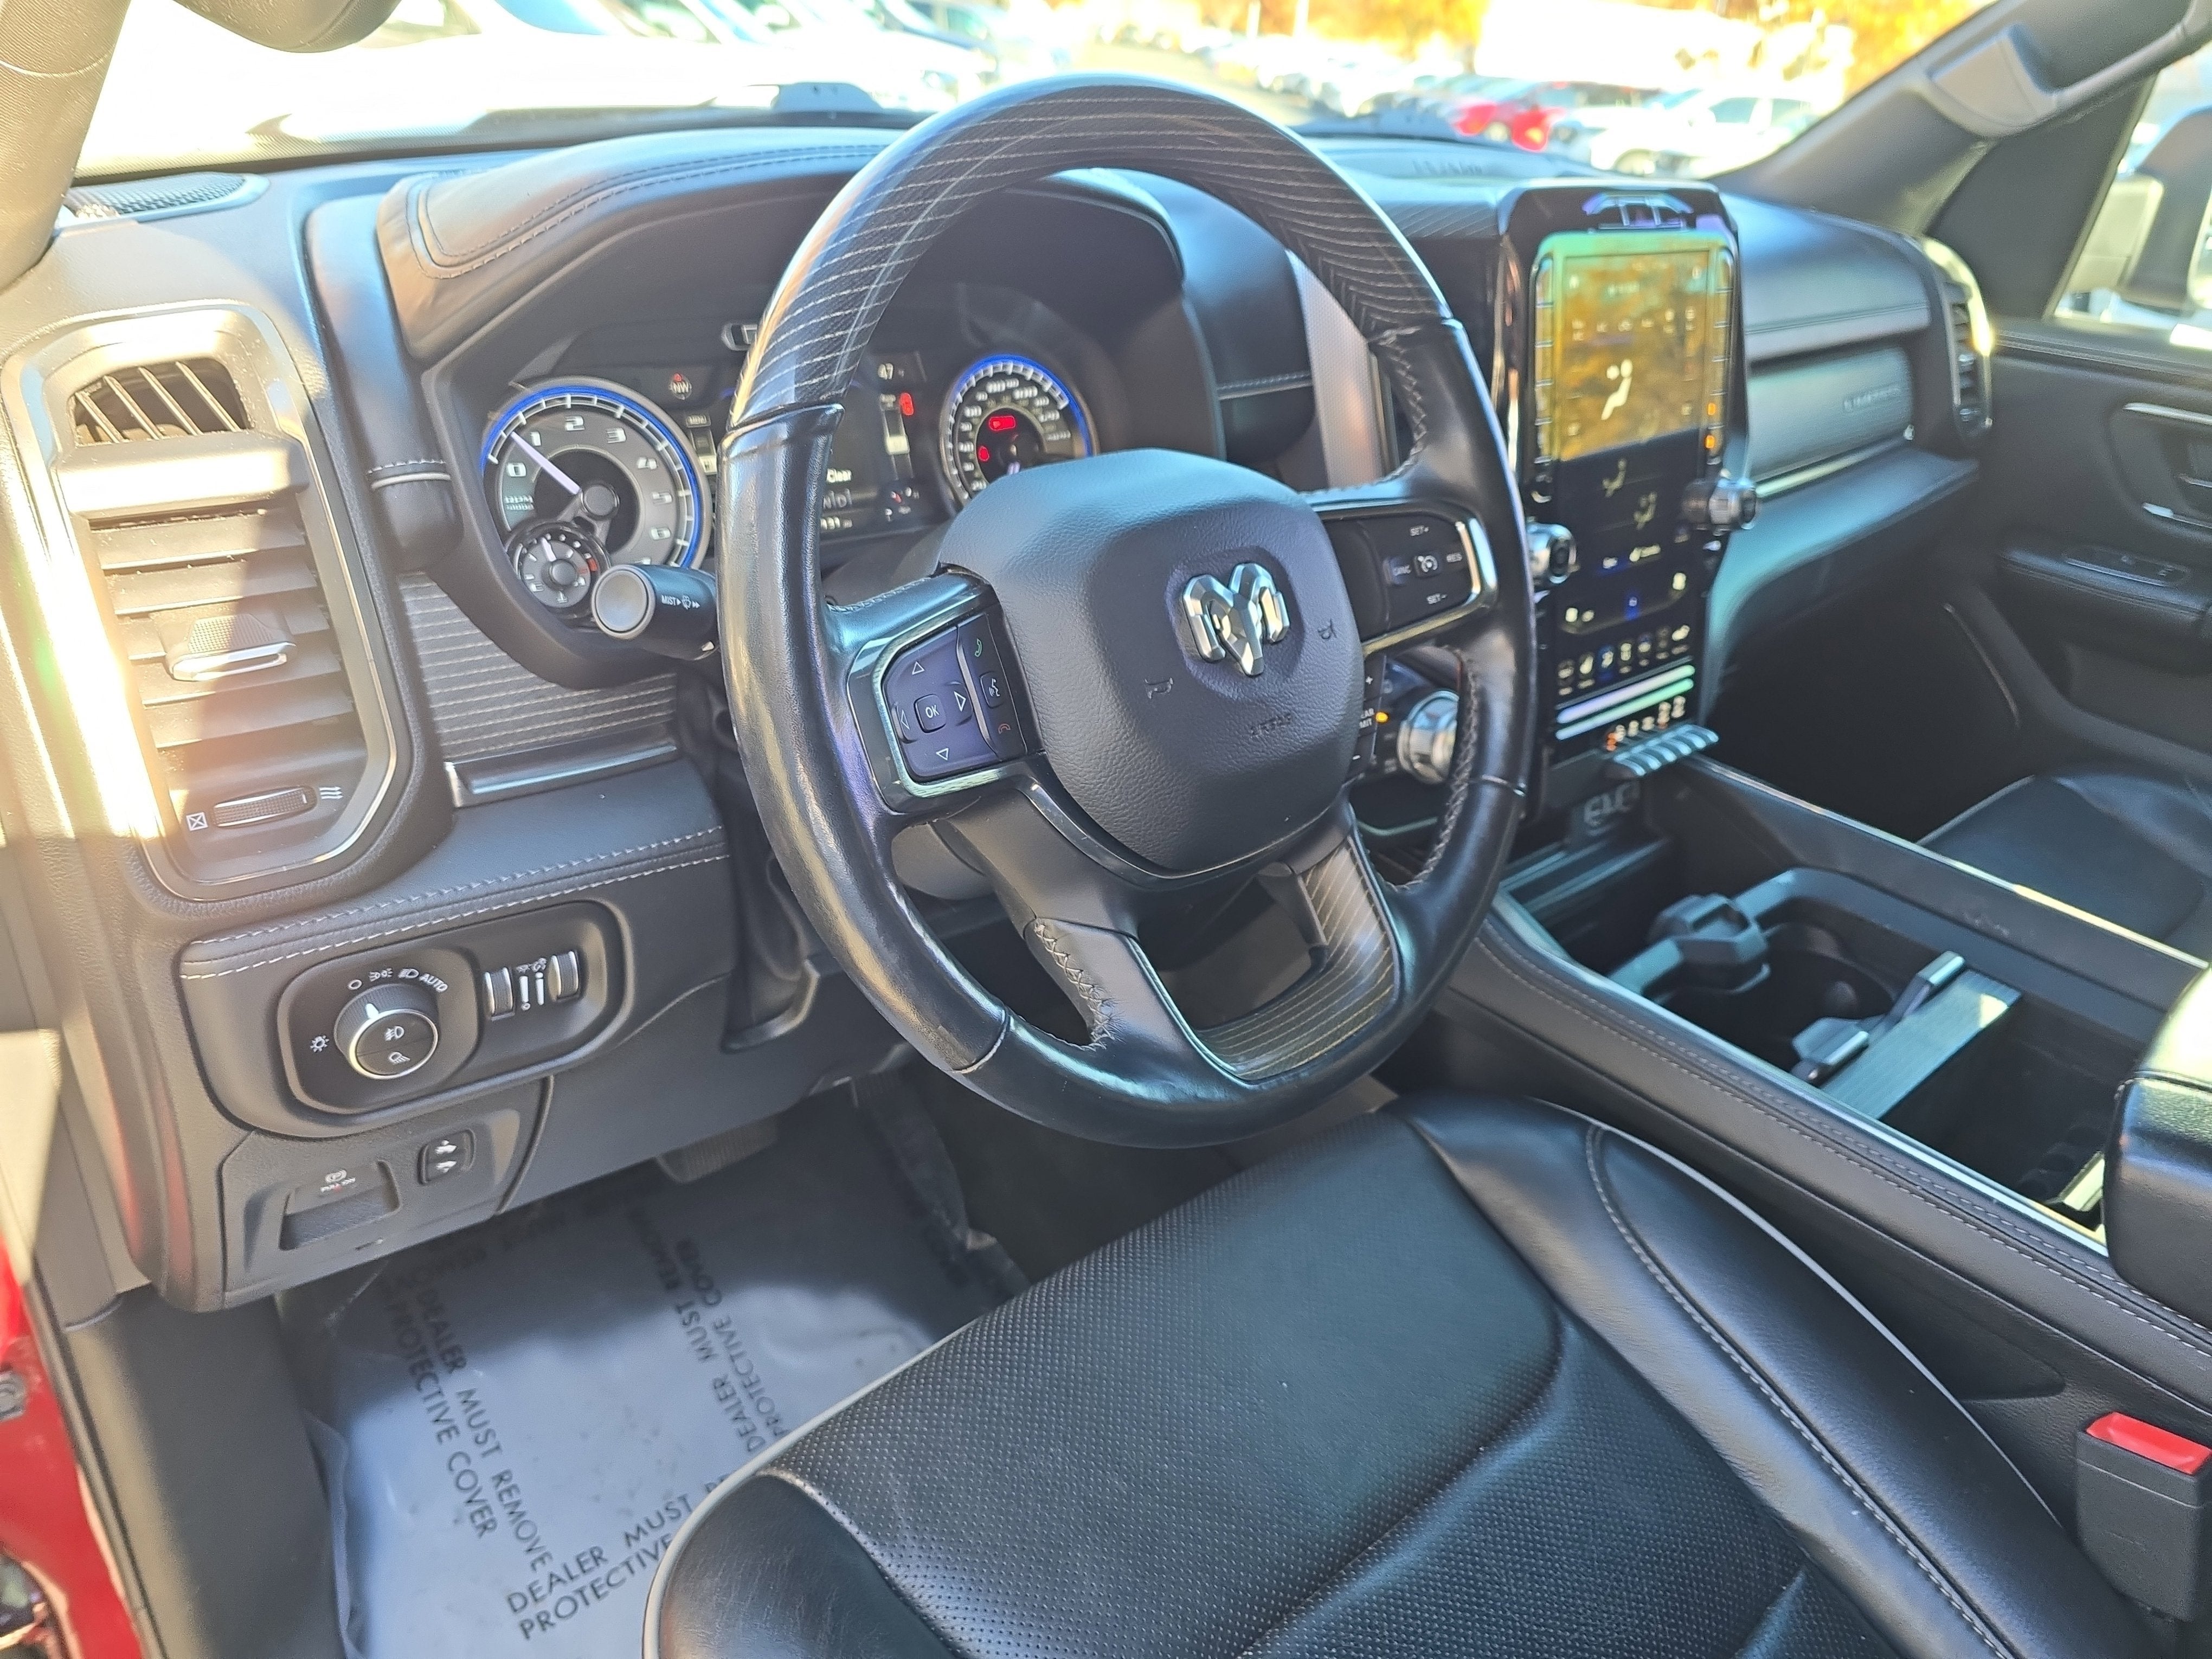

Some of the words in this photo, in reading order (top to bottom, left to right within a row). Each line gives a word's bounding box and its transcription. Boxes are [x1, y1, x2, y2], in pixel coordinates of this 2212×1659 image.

[530, 430, 542, 446] 1
[564, 415, 585, 431] 2
[506, 462, 526, 477] 0
[661, 594, 677, 606] MIST
[925, 709, 940, 719] OK
[419, 973, 448, 993] AUTO
[676, 1300, 718, 1363] MUST
[712, 1374, 766, 1452] DEALER
[446, 1450, 498, 1539] COVER
[455, 1387, 504, 1459] MUST
[491, 1468, 554, 1572] REMOVE
[506, 1546, 608, 1615] DEALER
[623, 1493, 693, 1548] MUST
[518, 1533, 673, 1641] PROTECTIVE
